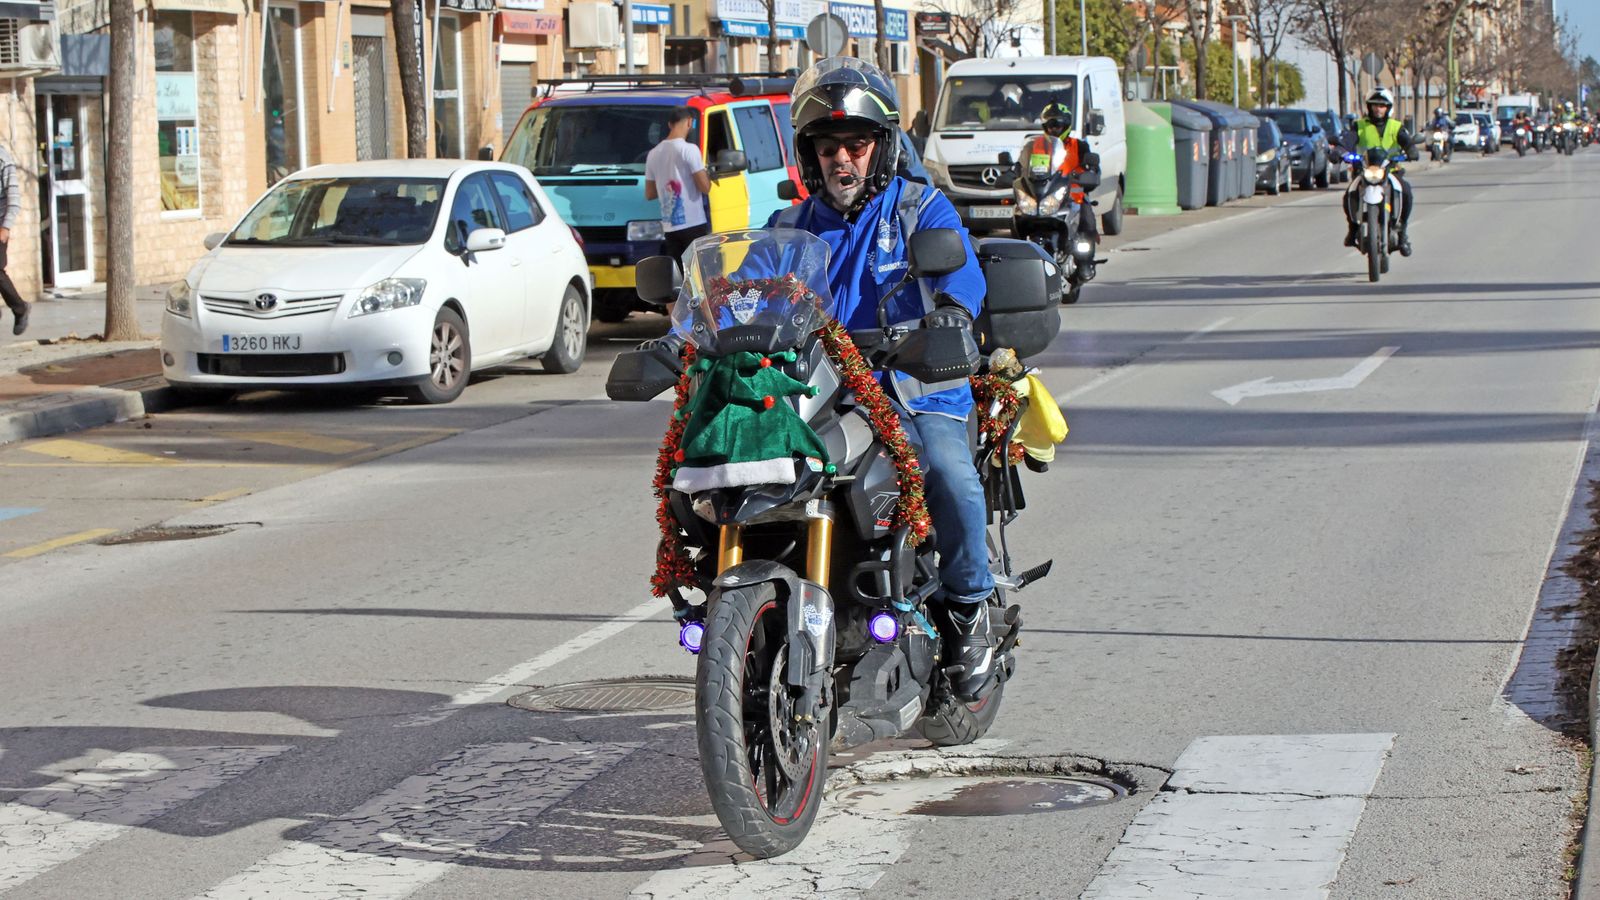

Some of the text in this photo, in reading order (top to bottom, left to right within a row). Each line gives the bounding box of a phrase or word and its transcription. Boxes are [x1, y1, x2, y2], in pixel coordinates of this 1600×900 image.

[885, 11, 906, 37] JEREZ
[231, 335, 301, 351] 3260 HKJ
